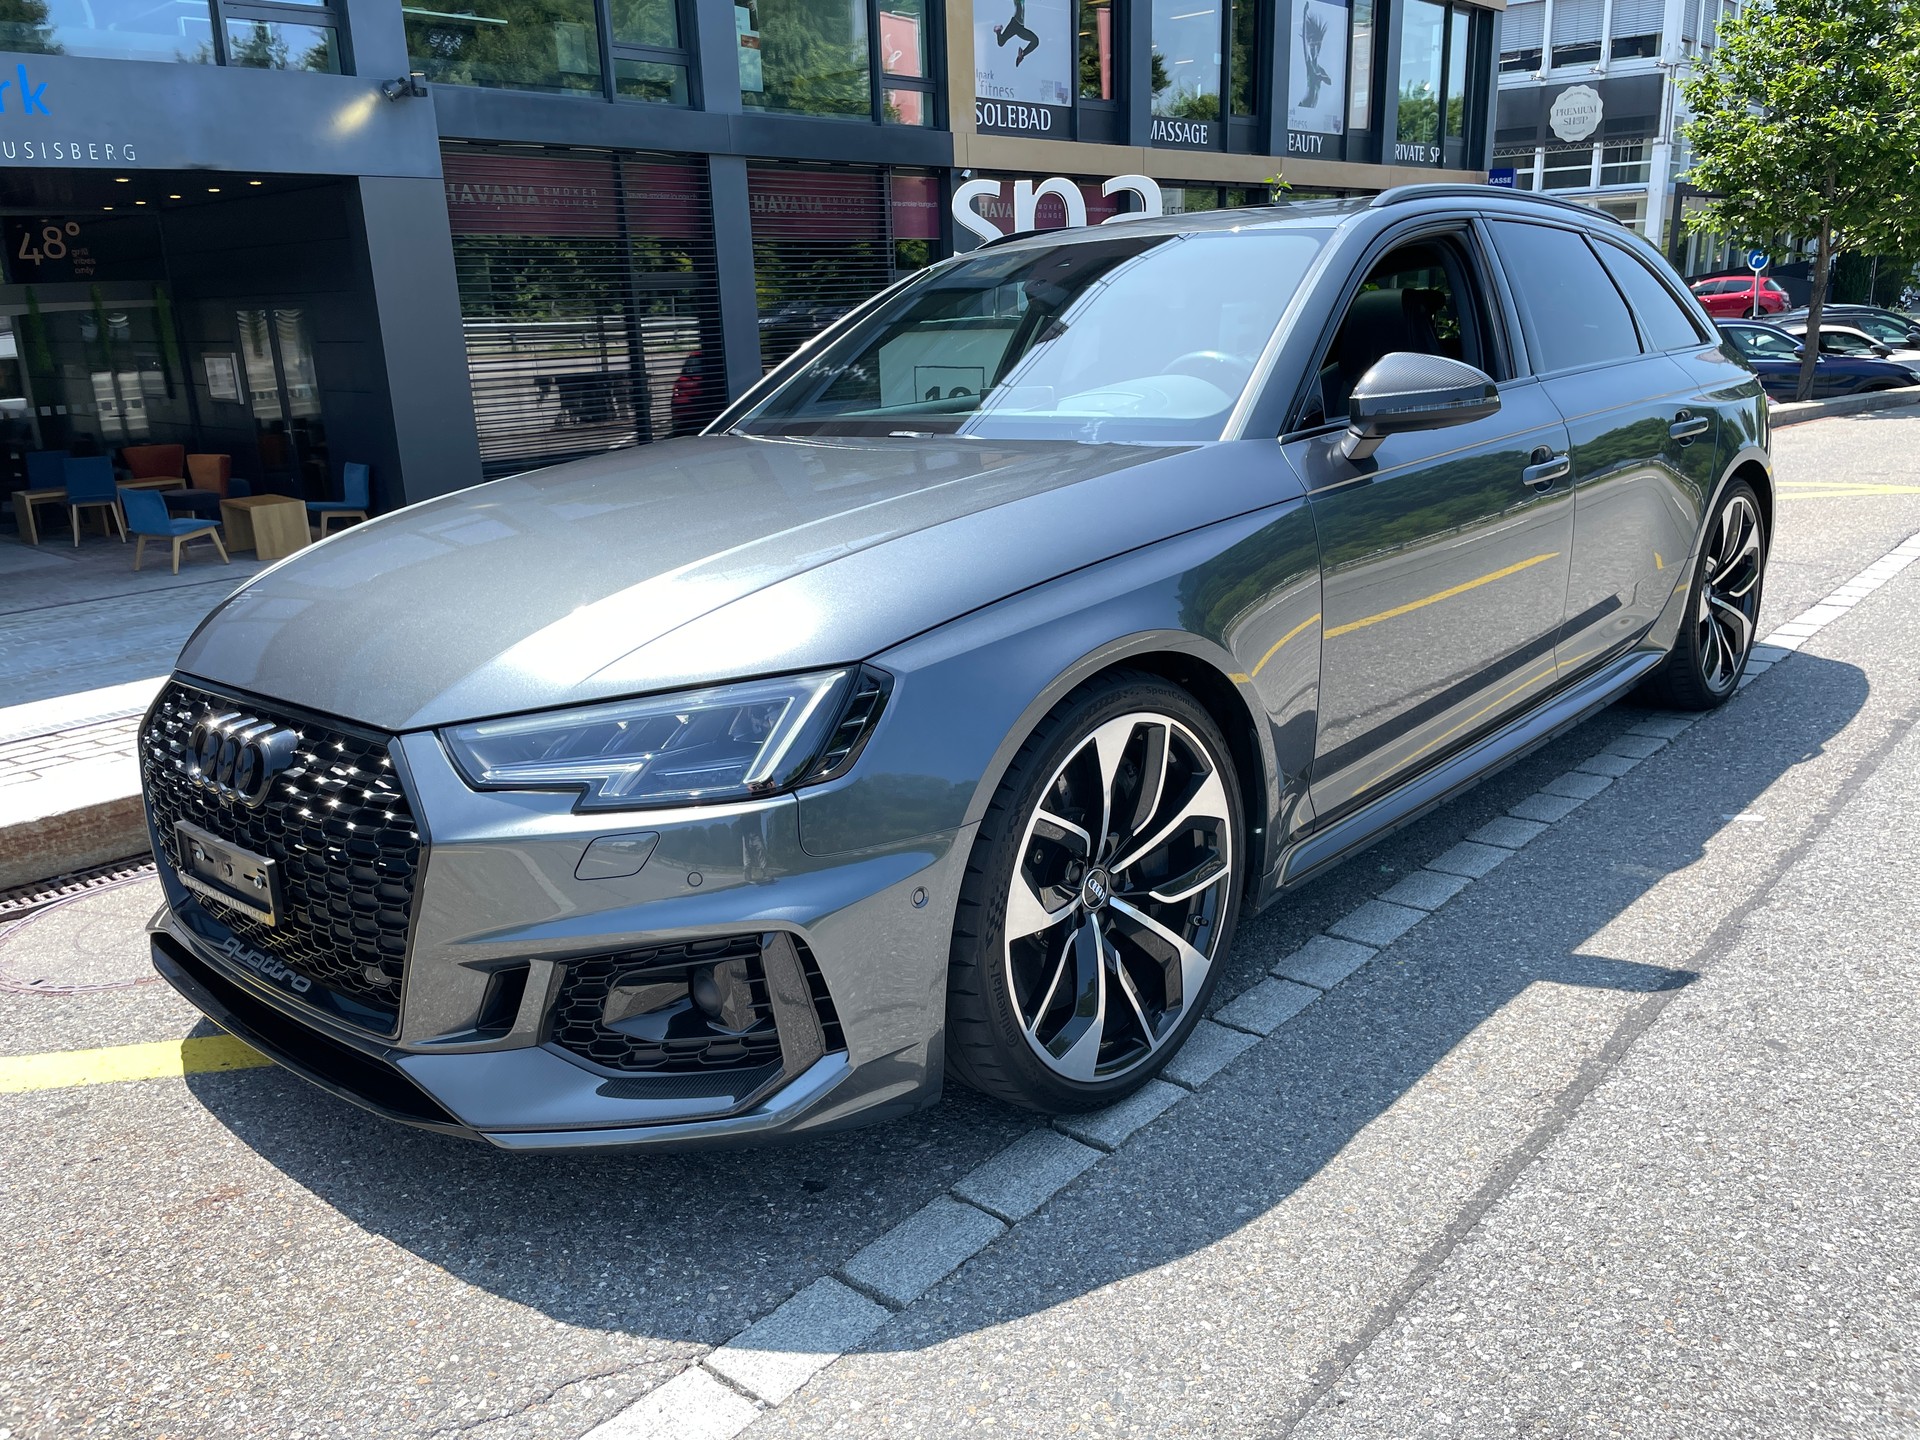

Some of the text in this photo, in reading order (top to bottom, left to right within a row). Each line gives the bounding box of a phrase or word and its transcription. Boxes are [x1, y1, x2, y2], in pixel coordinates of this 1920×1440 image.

[980, 81, 1015, 98] fitness
[976, 101, 1051, 131] SOLEBAD
[1556, 105, 1597, 117] PREMIUM
[2, 141, 136, 161] USISBERG
[1288, 133, 1324, 154] EAUTY
[1395, 143, 1425, 162] RIVATE
[1489, 176, 1512, 184] KASSE
[223, 936, 312, 993] quattro
